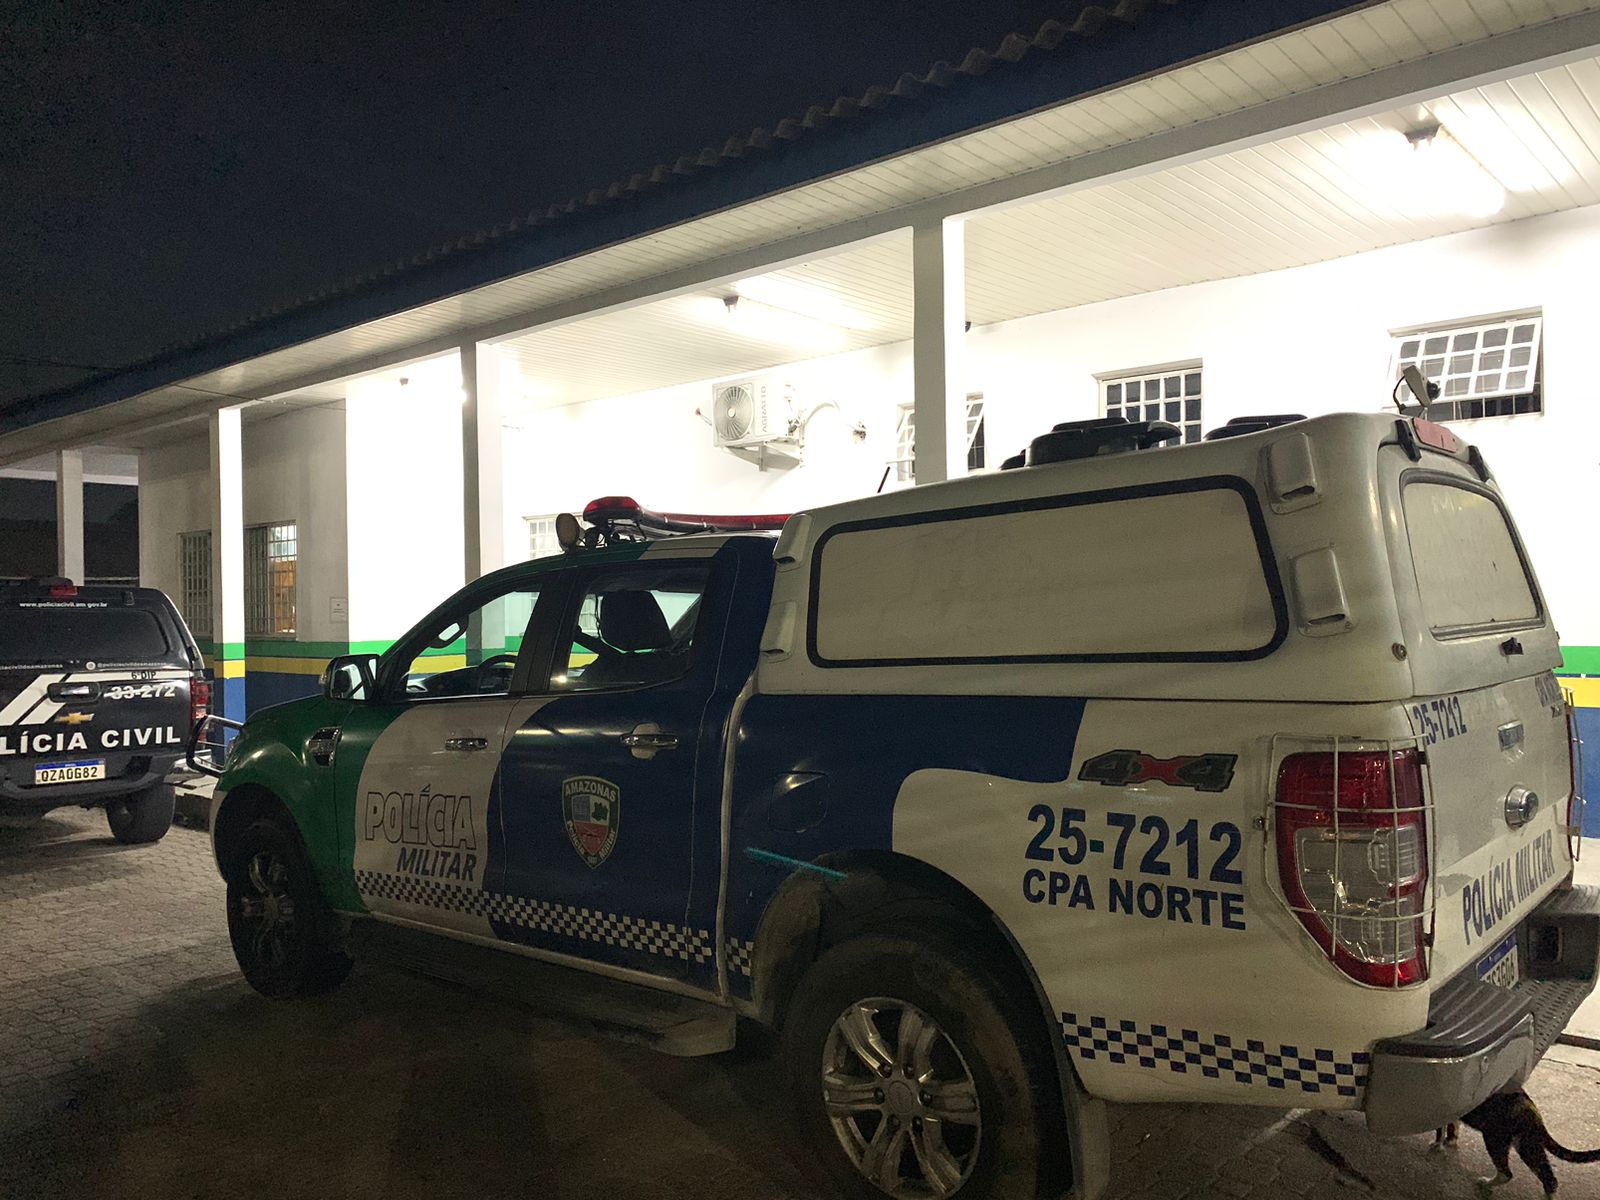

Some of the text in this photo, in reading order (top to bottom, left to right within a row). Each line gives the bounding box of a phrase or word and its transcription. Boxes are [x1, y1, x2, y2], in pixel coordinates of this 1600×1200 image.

[101, 726, 181, 748] CIVIL
[1412, 696, 1467, 745] 25-7212
[365, 784, 477, 850] POLÍCIA
[565, 780, 617, 803] AMAZONAS
[396, 847, 476, 881] MILITAR
[1025, 803, 1243, 885] 25-7212
[1022, 868, 1246, 930] CPA NORTE
[1463, 829, 1556, 946] POLÍCIA MILITAR
